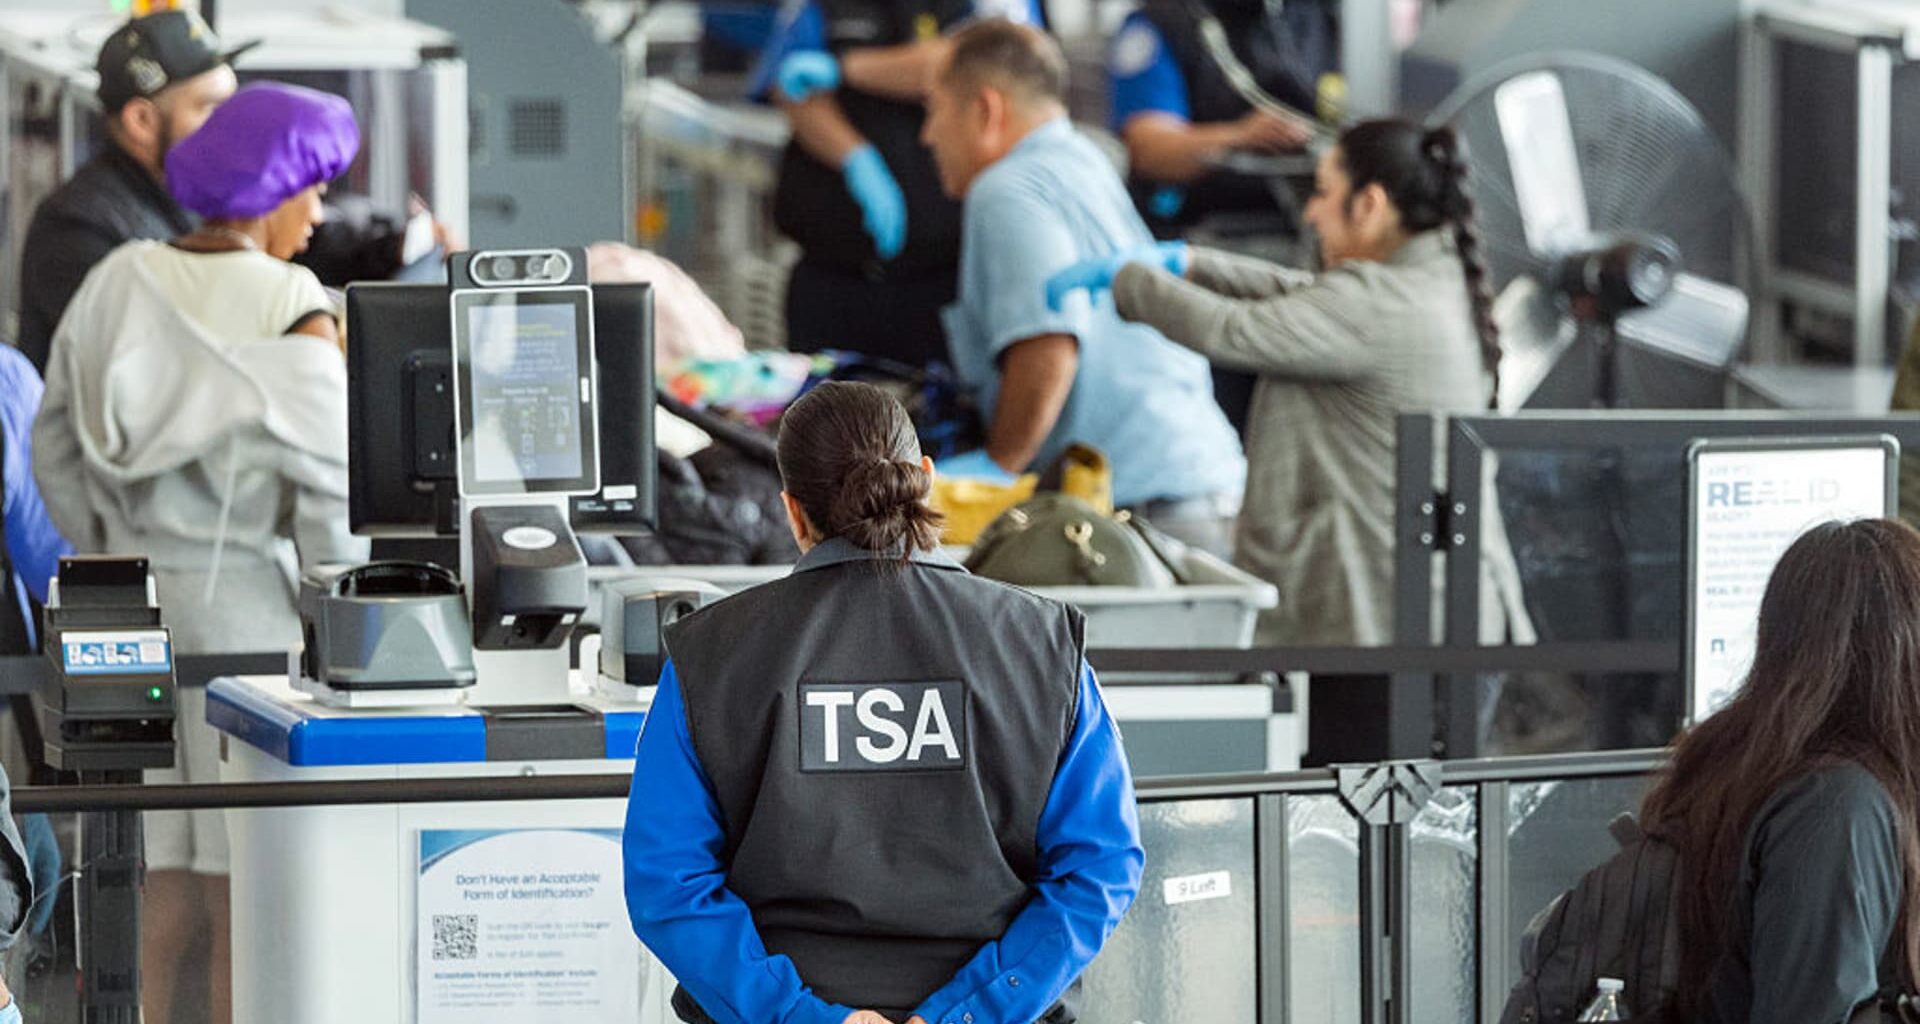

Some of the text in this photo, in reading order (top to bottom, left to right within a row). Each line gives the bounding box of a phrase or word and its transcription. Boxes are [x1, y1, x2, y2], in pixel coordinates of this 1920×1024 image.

[806, 688, 961, 763] TSA
[456, 872, 600, 885] Don't Have an Acceptable
[463, 887, 595, 900] Form of Identification?
[1178, 881, 1188, 896] 9
